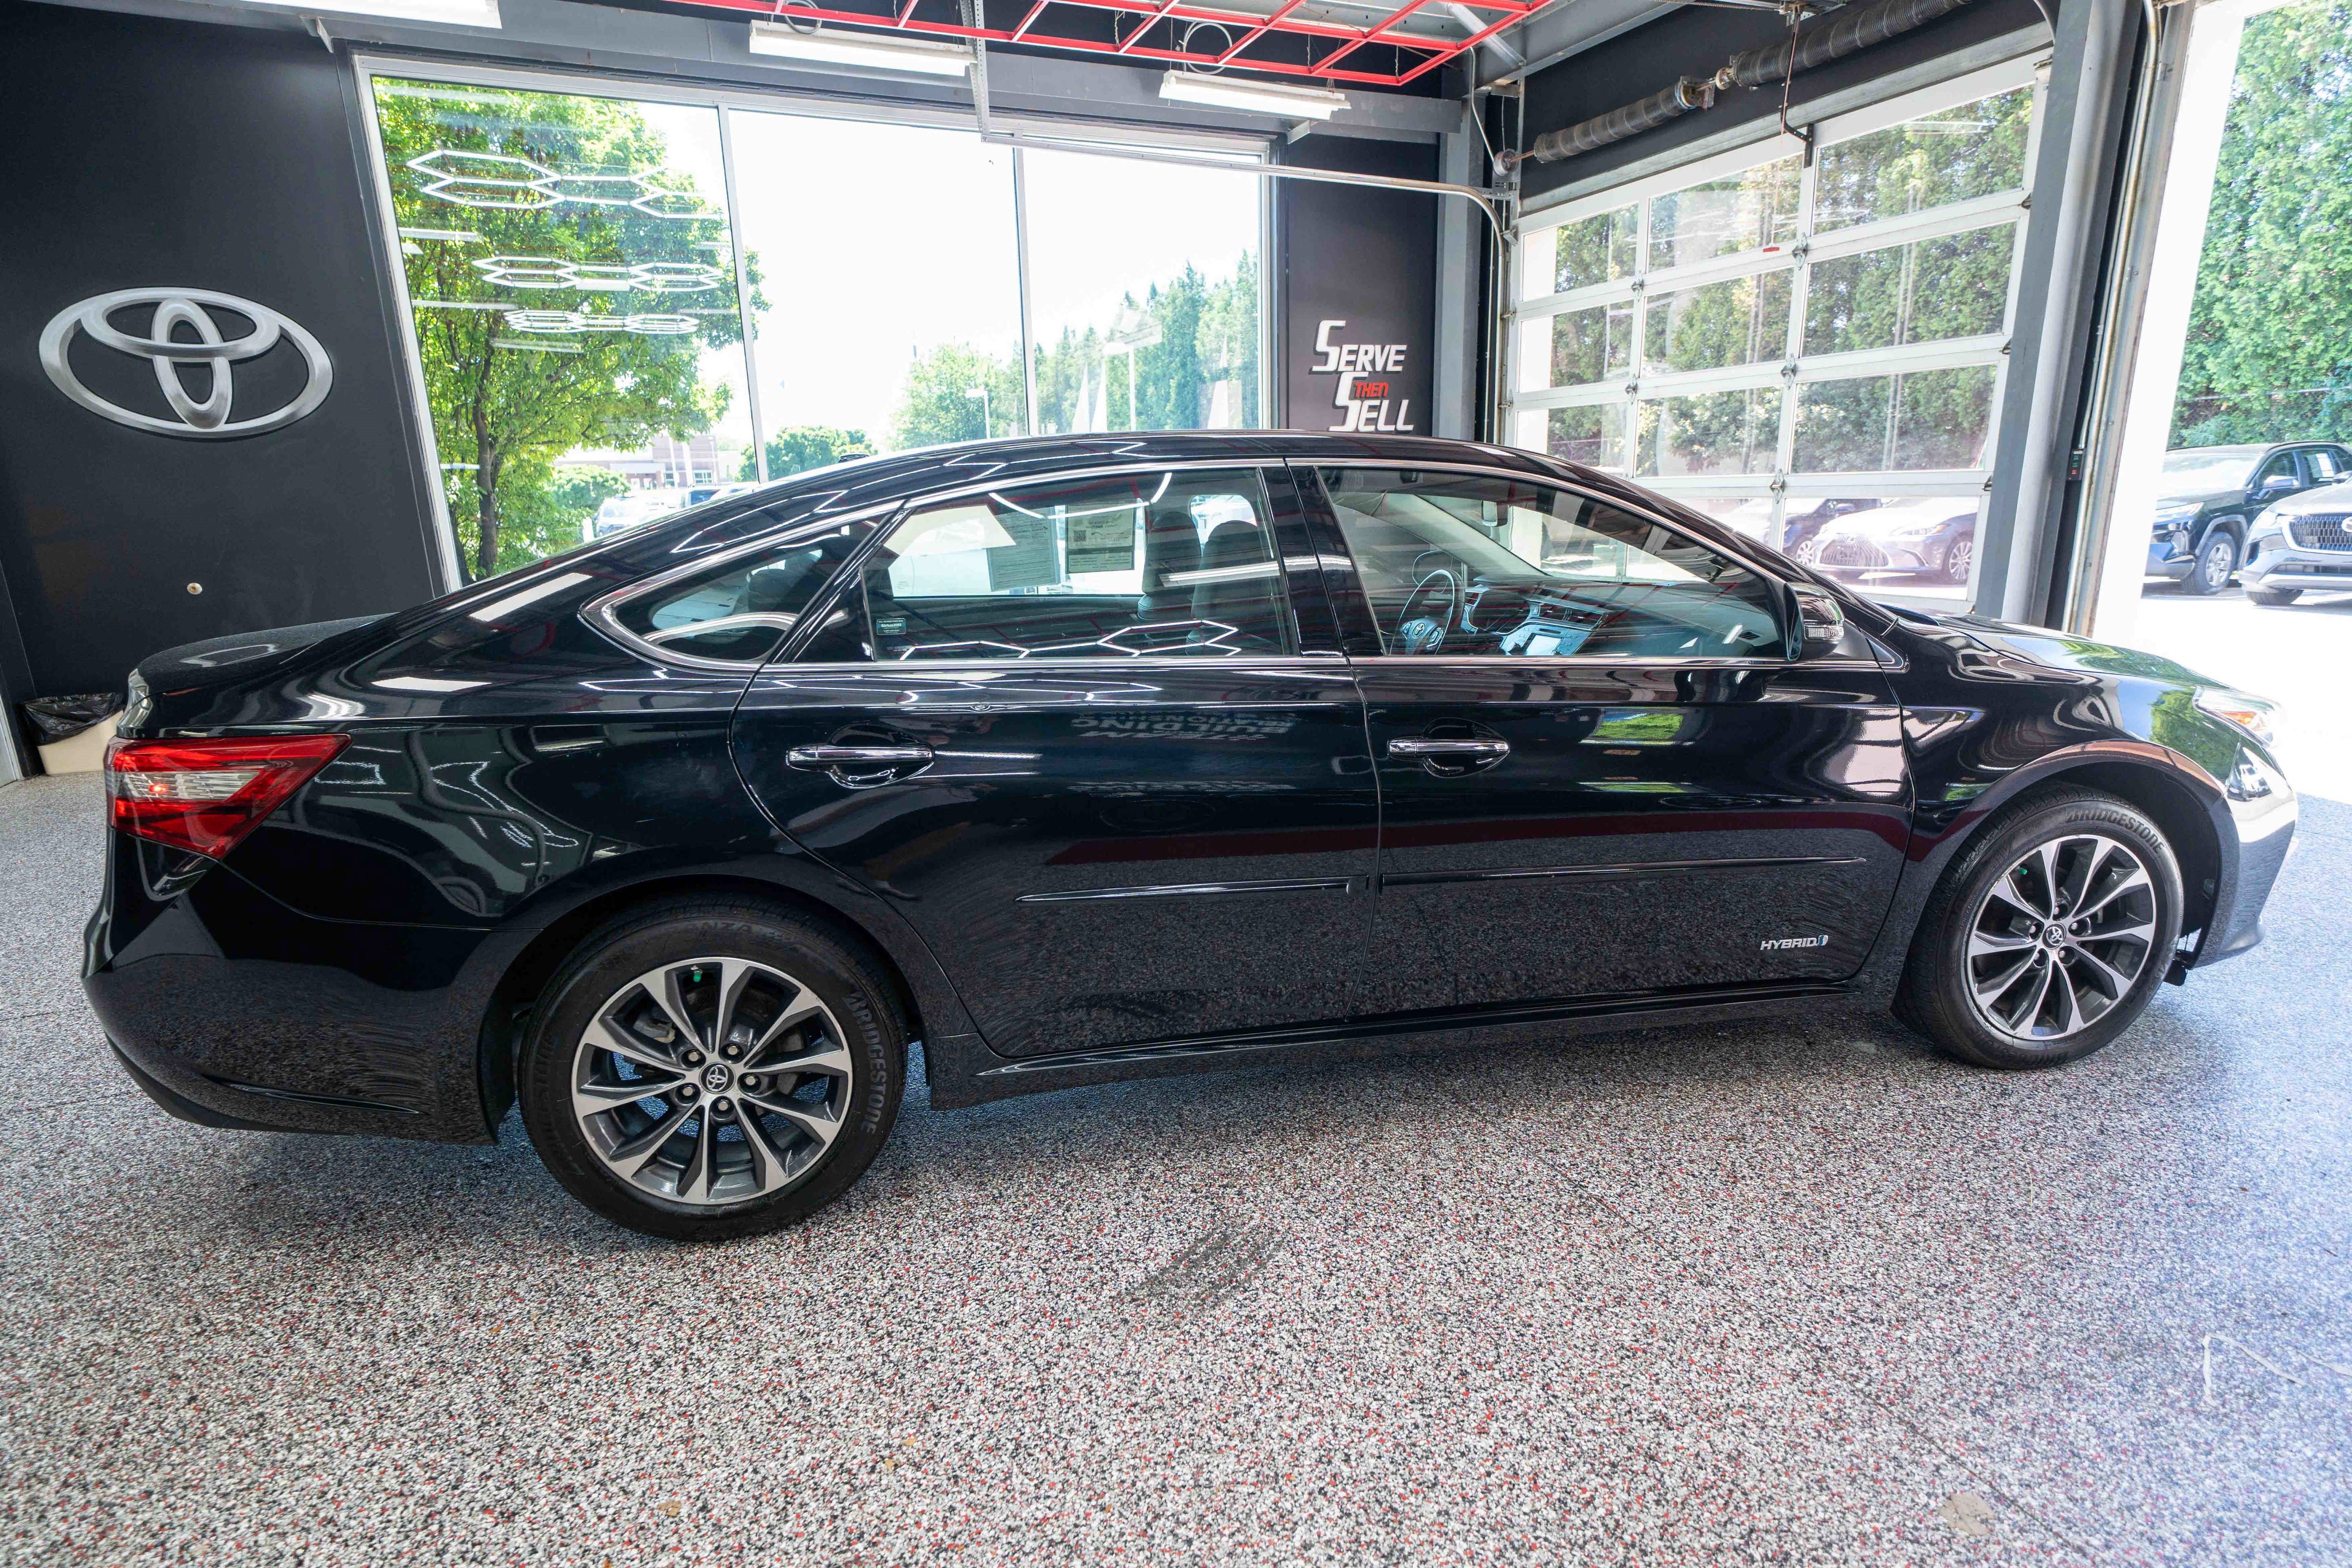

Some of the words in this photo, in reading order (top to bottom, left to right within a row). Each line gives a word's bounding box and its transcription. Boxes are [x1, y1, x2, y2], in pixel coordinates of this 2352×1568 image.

[1312, 320, 1408, 372] SERVE
[1329, 371, 1414, 432] SELL
[2065, 810, 2165, 853] BRIDGESTONE
[1760, 937, 1819, 950] HYBRID
[842, 991, 887, 1134] BRIDGESTONE
